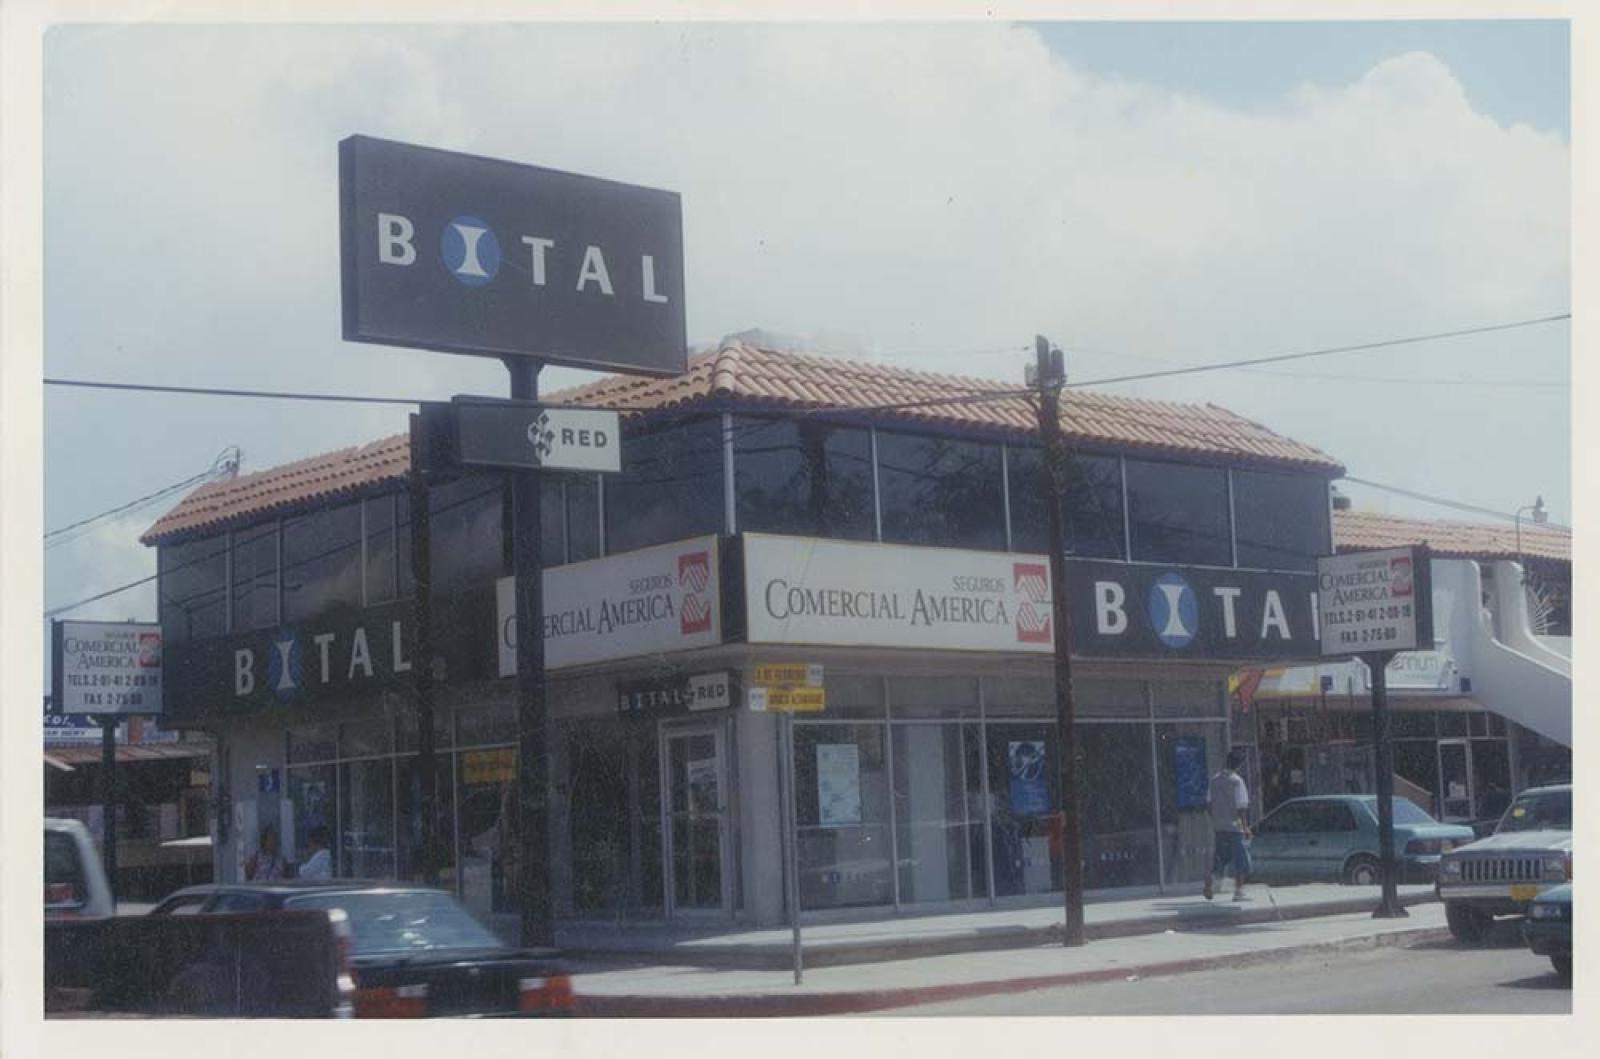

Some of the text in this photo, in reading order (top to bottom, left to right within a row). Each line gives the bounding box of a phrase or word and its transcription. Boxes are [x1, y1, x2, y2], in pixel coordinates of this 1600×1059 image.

[377, 212, 669, 304] BITAL
[561, 427, 608, 450] RED
[629, 573, 674, 596] SEGUROS
[951, 575, 1006, 593] SEGUROS
[1319, 568, 1392, 593] COMERCIAL
[765, 578, 1010, 627] COMERCIAL AMERICA
[1331, 585, 1389, 607] AMERICA
[503, 593, 676, 649] CERCIAL AMERICA
[65, 637, 141, 655] COMERCIAL
[78, 653, 137, 669] AMERICA
[234, 620, 412, 697] BITAL
[697, 682, 726, 702] RED
